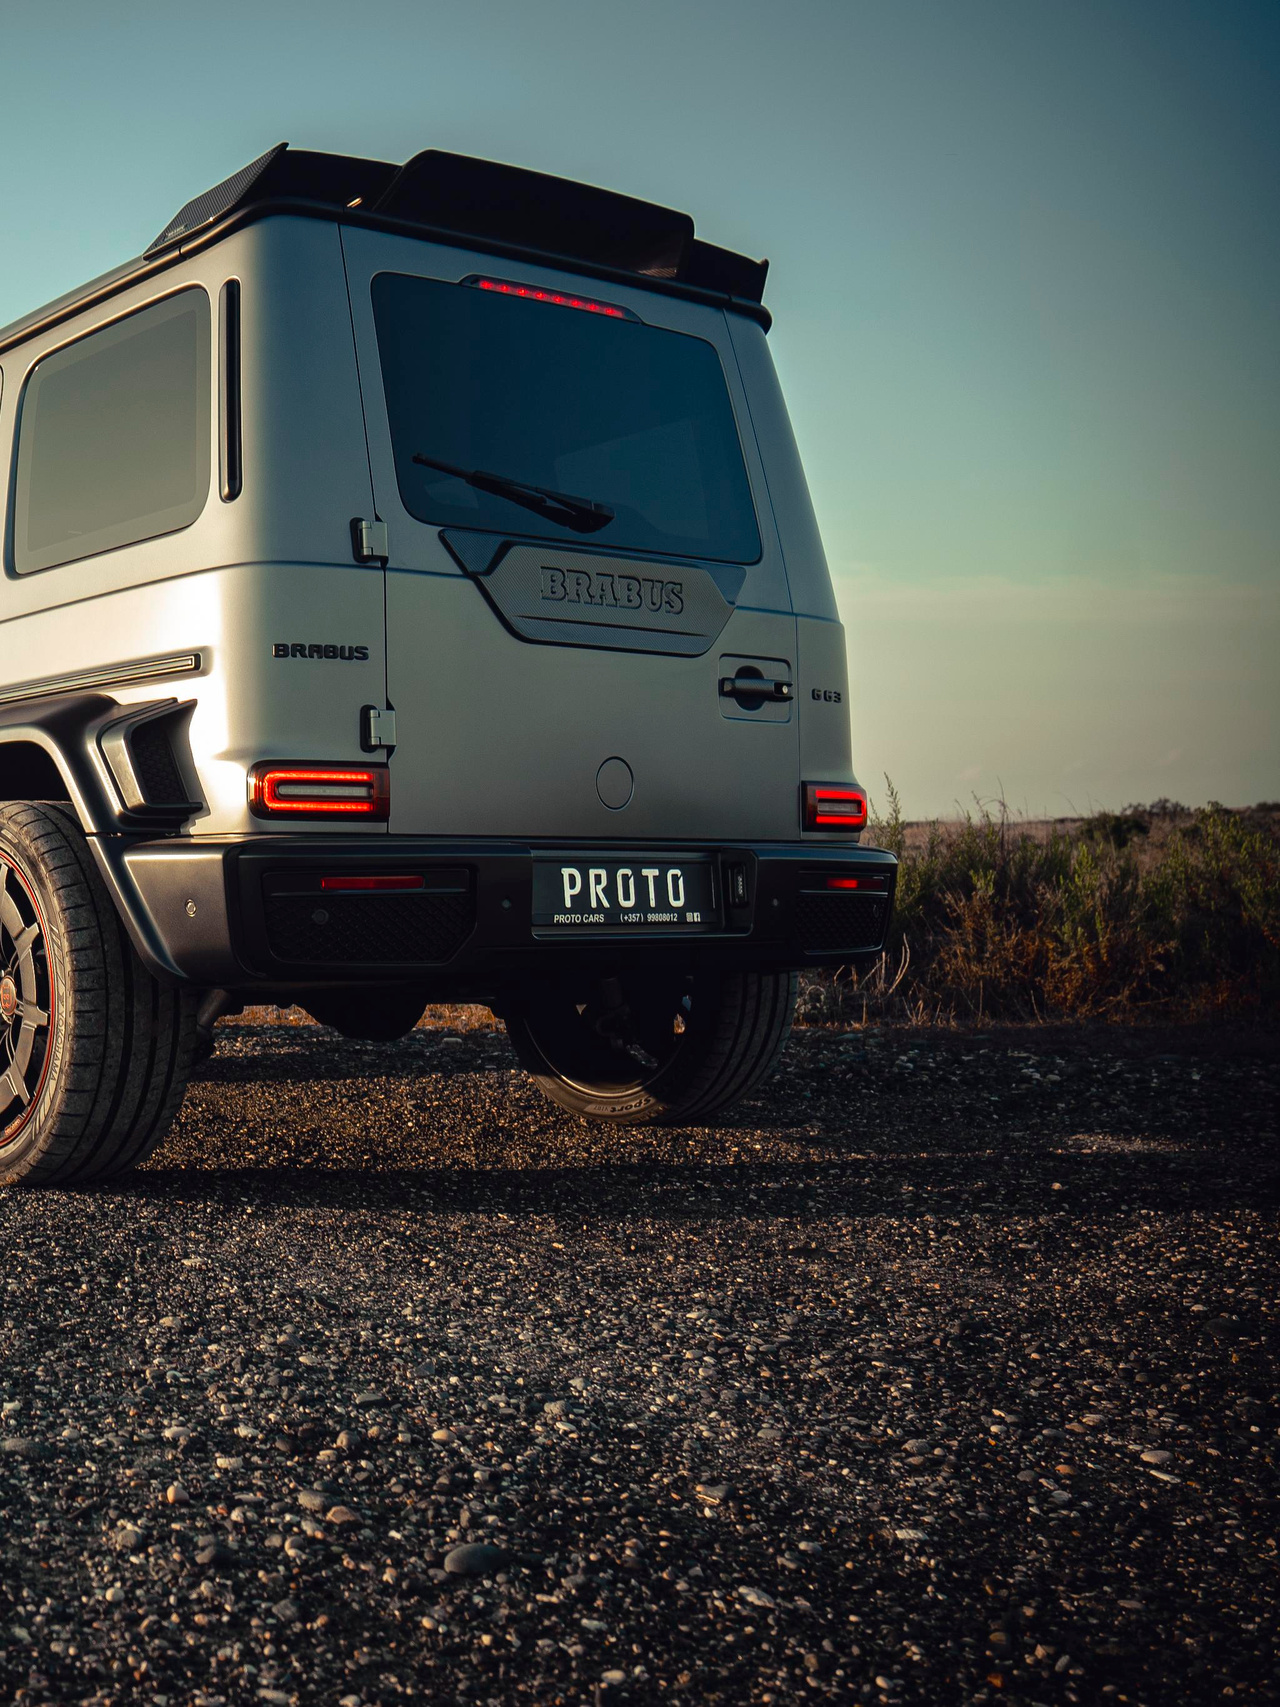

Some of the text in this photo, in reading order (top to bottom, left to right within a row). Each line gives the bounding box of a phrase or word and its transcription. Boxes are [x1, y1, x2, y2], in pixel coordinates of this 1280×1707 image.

[540, 566, 684, 615] BRABUS
[272, 643, 369, 661] BRABUS
[561, 867, 685, 908] PROTO
[553, 914, 581, 924] PROTO
[583, 914, 605, 923] CARS
[51, 1012, 64, 1081] YOKOHAMA
[610, 1095, 652, 1113] Sport
